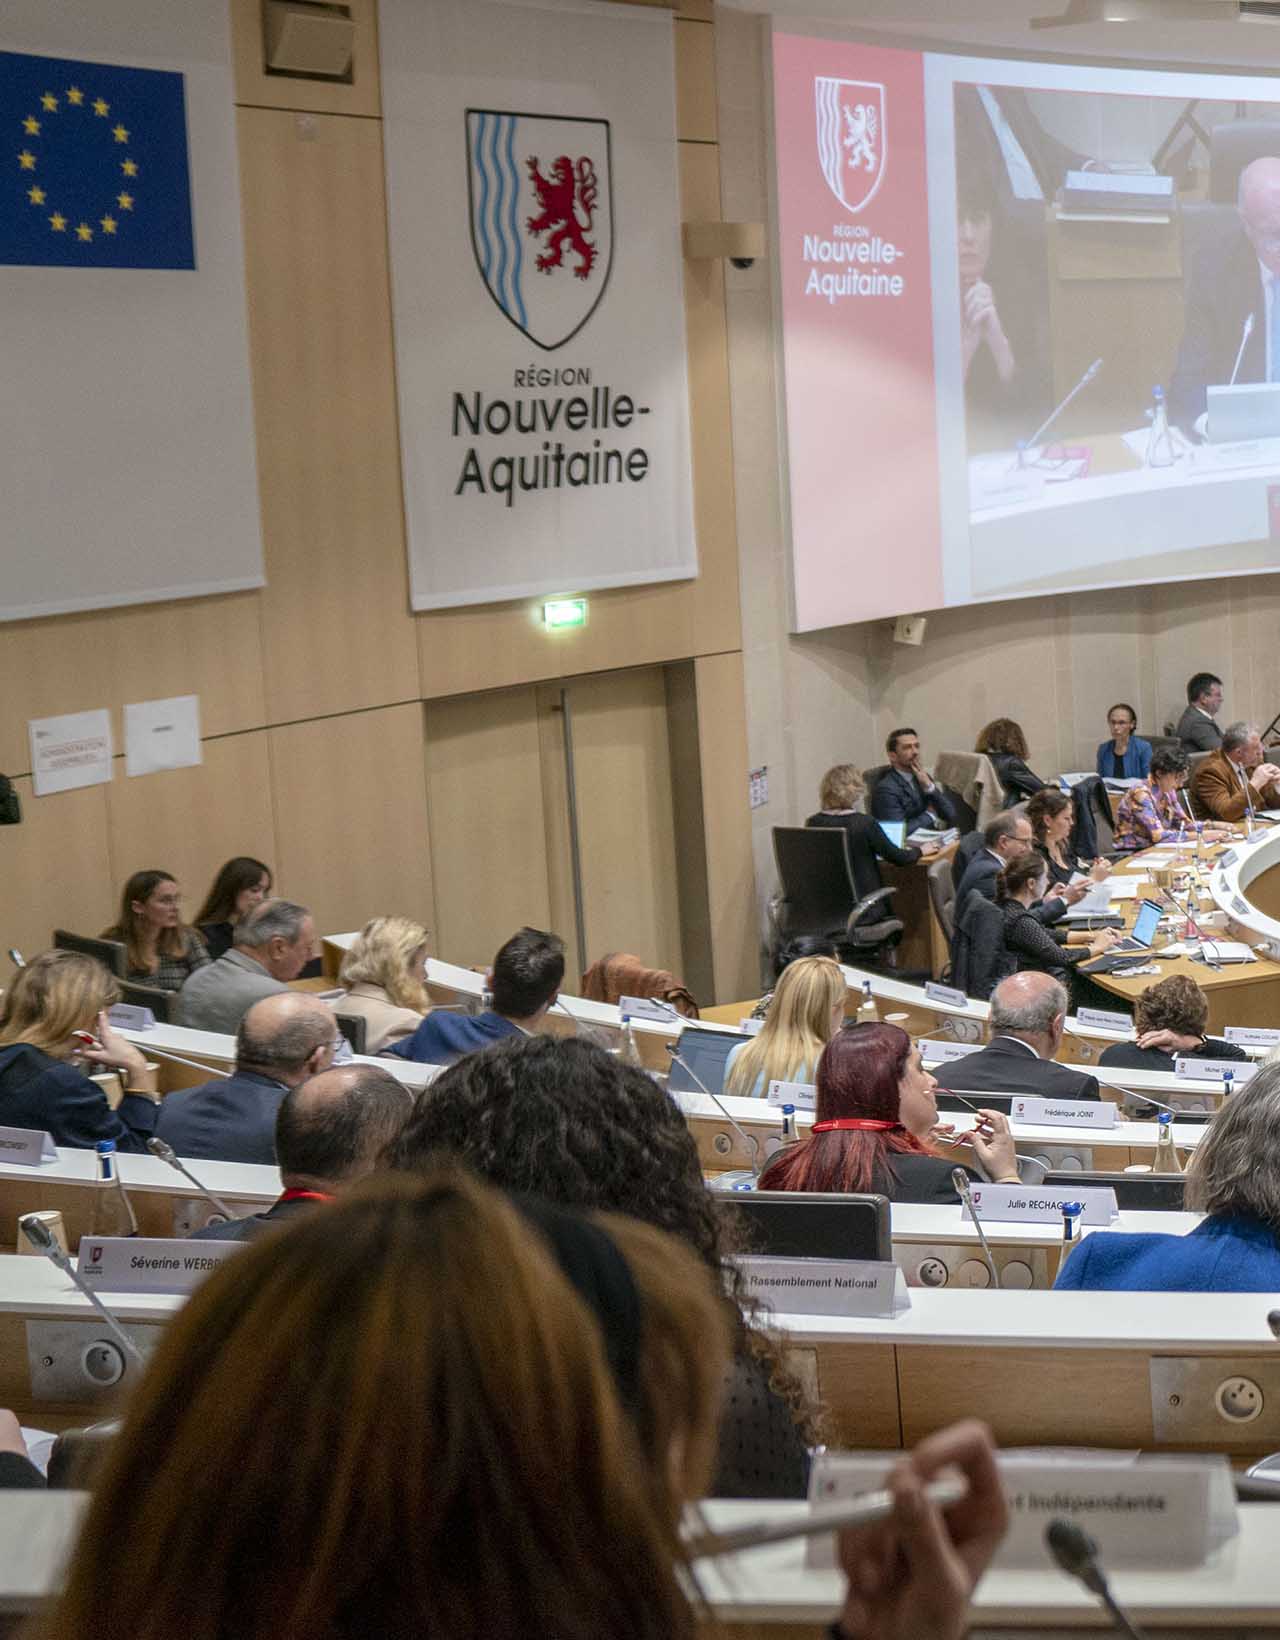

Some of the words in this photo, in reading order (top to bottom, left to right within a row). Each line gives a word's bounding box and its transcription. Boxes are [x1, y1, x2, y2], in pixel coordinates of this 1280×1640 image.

[802, 234, 905, 264] Nouvelle-
[804, 267, 905, 304] Aquitaine
[513, 363, 592, 388] RÉGION
[451, 386, 651, 437] Nouvelle-
[455, 439, 649, 508] Aquitaine
[1044, 1108, 1075, 1118] Frédérique
[1076, 1109, 1094, 1118] JOINT
[1007, 1199, 1026, 1209] Julie
[1028, 1200, 1087, 1211] RECHAGX
[130, 1255, 180, 1270] Séverine
[751, 1274, 832, 1289] Rassemblement
[834, 1277, 879, 1290] National
